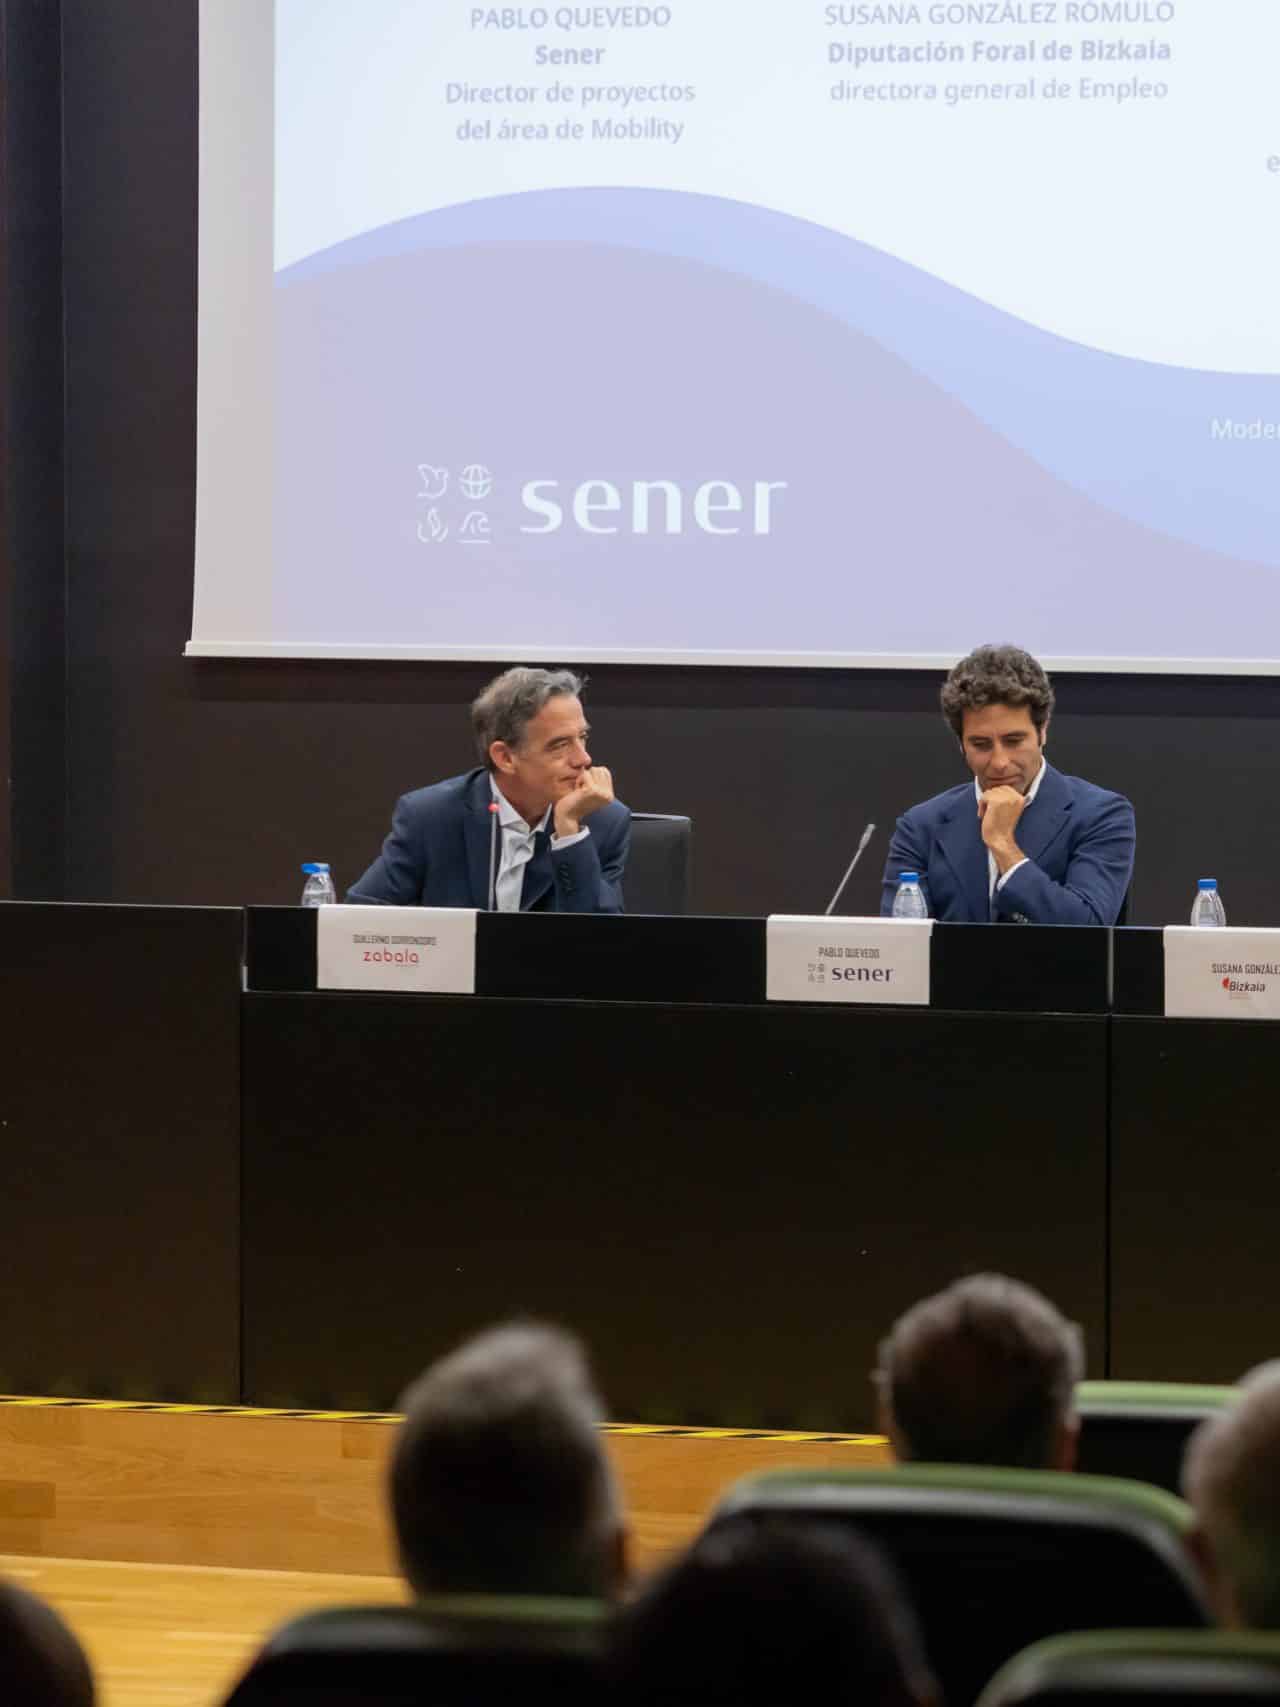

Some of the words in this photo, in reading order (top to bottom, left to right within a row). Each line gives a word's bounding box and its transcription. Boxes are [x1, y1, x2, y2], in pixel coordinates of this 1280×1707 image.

[470, 7, 549, 30] PABLO
[554, 5, 672, 32] QUEVEDO
[824, 3, 922, 27] SUSANA
[534, 44, 606, 66] Sener
[828, 40, 965, 69] Diputación
[972, 39, 1036, 63] Foral
[1041, 39, 1073, 62] de
[1080, 39, 1171, 62] Bizkaia
[445, 81, 539, 105] Director
[545, 80, 575, 103] de
[580, 83, 696, 109] proyectos
[830, 79, 939, 102] directora
[943, 78, 1036, 108] general
[1041, 78, 1072, 99] de
[1078, 76, 1169, 105] Empleo
[455, 119, 491, 142] del
[496, 118, 549, 141] área
[555, 118, 585, 141] de
[591, 116, 685, 145] Mobility
[520, 480, 788, 534] sener
[363, 947, 420, 964] zabala
[818, 946, 843, 958] PABLO
[845, 947, 880, 959] QUEVEDO
[831, 966, 894, 983] sener
[1211, 963, 1243, 974] SUSANA
[1229, 981, 1266, 993] Bizkaia
